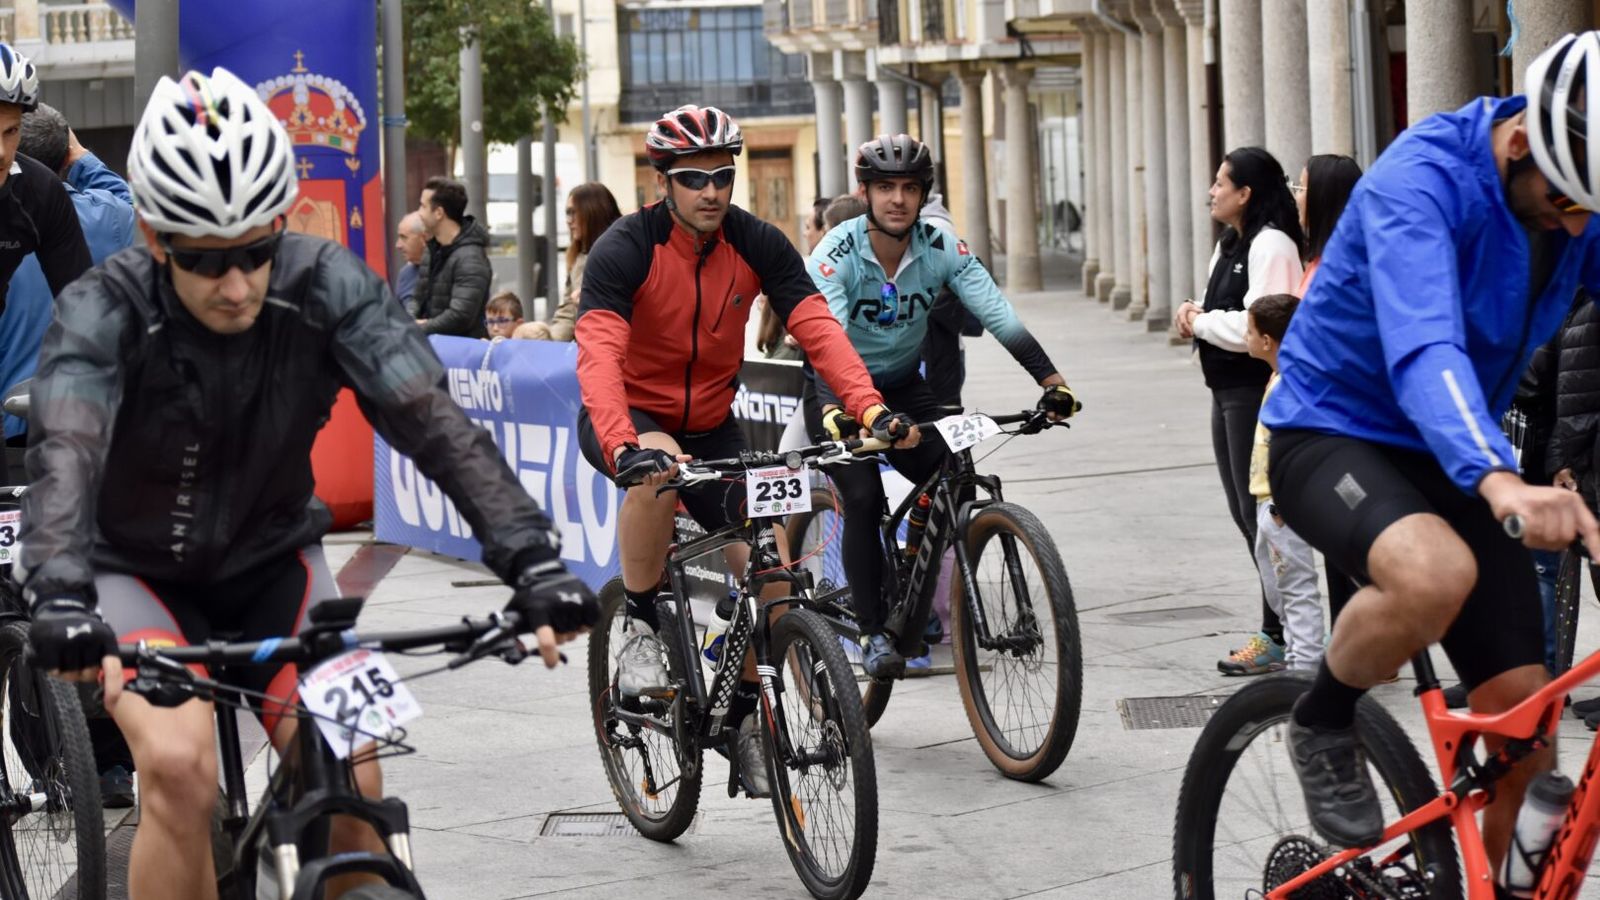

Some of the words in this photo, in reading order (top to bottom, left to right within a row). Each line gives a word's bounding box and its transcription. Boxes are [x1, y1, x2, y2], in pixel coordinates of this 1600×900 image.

[947, 416, 984, 439] 247
[755, 478, 803, 502] 233
[324, 667, 394, 724] 215
